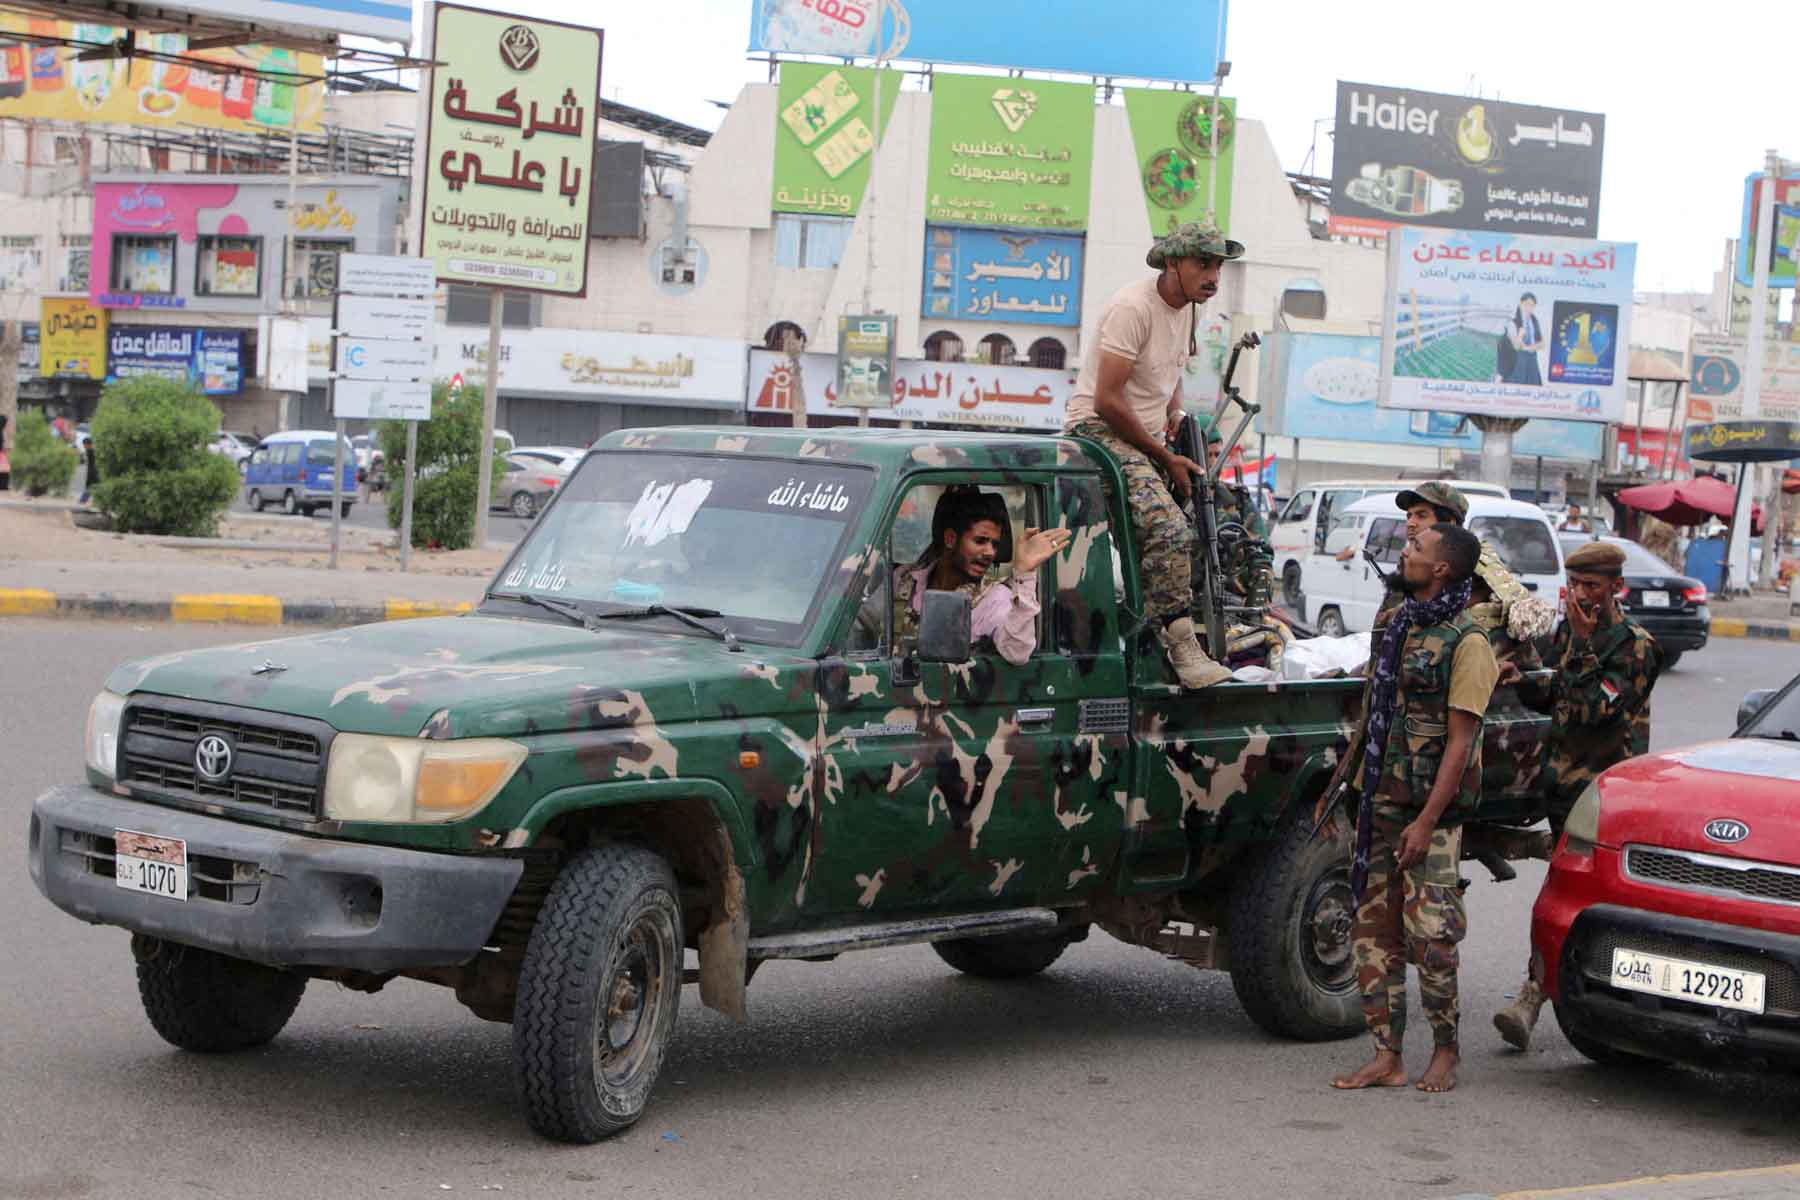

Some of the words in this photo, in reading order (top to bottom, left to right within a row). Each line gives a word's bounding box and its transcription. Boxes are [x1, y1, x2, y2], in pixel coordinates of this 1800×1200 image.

[444, 78, 584, 139] شركة
[1350, 92, 1439, 136] Haier
[1509, 115, 1593, 147] هاير
[440, 150, 546, 192] علي
[559, 156, 581, 207] با
[432, 205, 516, 237] والتحويلات
[523, 215, 582, 243] للصرافة
[965, 249, 1071, 282] الأمير
[1413, 238, 1472, 264] عدن
[1479, 244, 1554, 268] سماء
[1560, 246, 1617, 275] أكيد
[958, 376, 1055, 410] عدن
[937, 411, 1026, 426] INTERNATIONAL
[767, 478, 806, 508] الله
[799, 483, 849, 513] ماشاء
[1711, 823, 1740, 839] KIA
[139, 862, 176, 895] 1070
[1631, 974, 1652, 985] ADEN
[1681, 969, 1744, 1002] 12928
